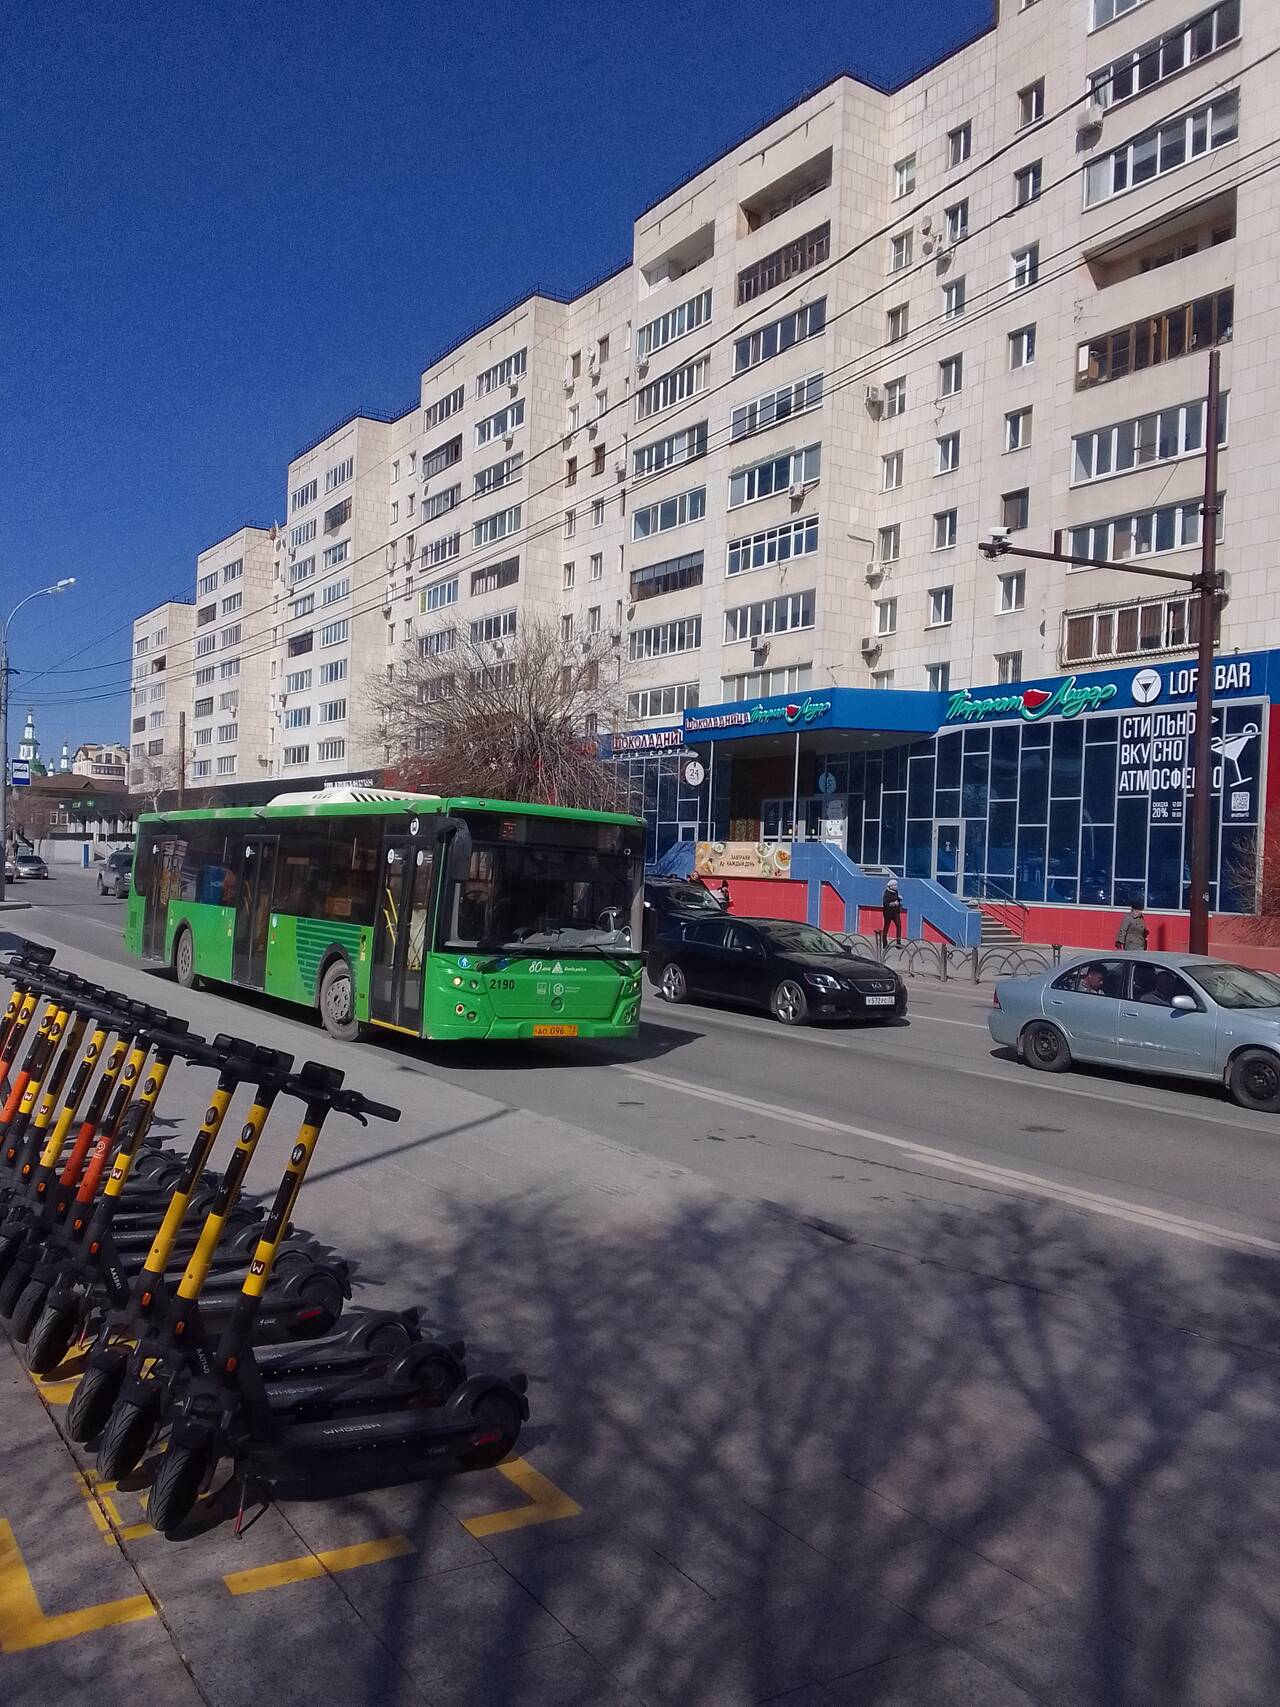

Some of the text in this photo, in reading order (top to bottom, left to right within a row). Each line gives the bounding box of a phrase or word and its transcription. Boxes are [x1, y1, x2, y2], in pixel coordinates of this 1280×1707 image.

[1169, 662, 1251, 695] LOF BAR
[1022, 676, 1118, 722] Лидер
[685, 711, 751, 732] ШОКОЛАДНИЦА
[1122, 712, 1197, 739] СТИЛЬНО
[1121, 740, 1183, 765] ВКУСНО
[1119, 765, 1223, 792] АТМОСФЕО
[1152, 808, 1168, 818] 20%
[529, 961, 543, 973] 80
[490, 979, 515, 990] 2190
[550, 1026, 565, 1035] 096
[251, 1261, 264, 1274] W
